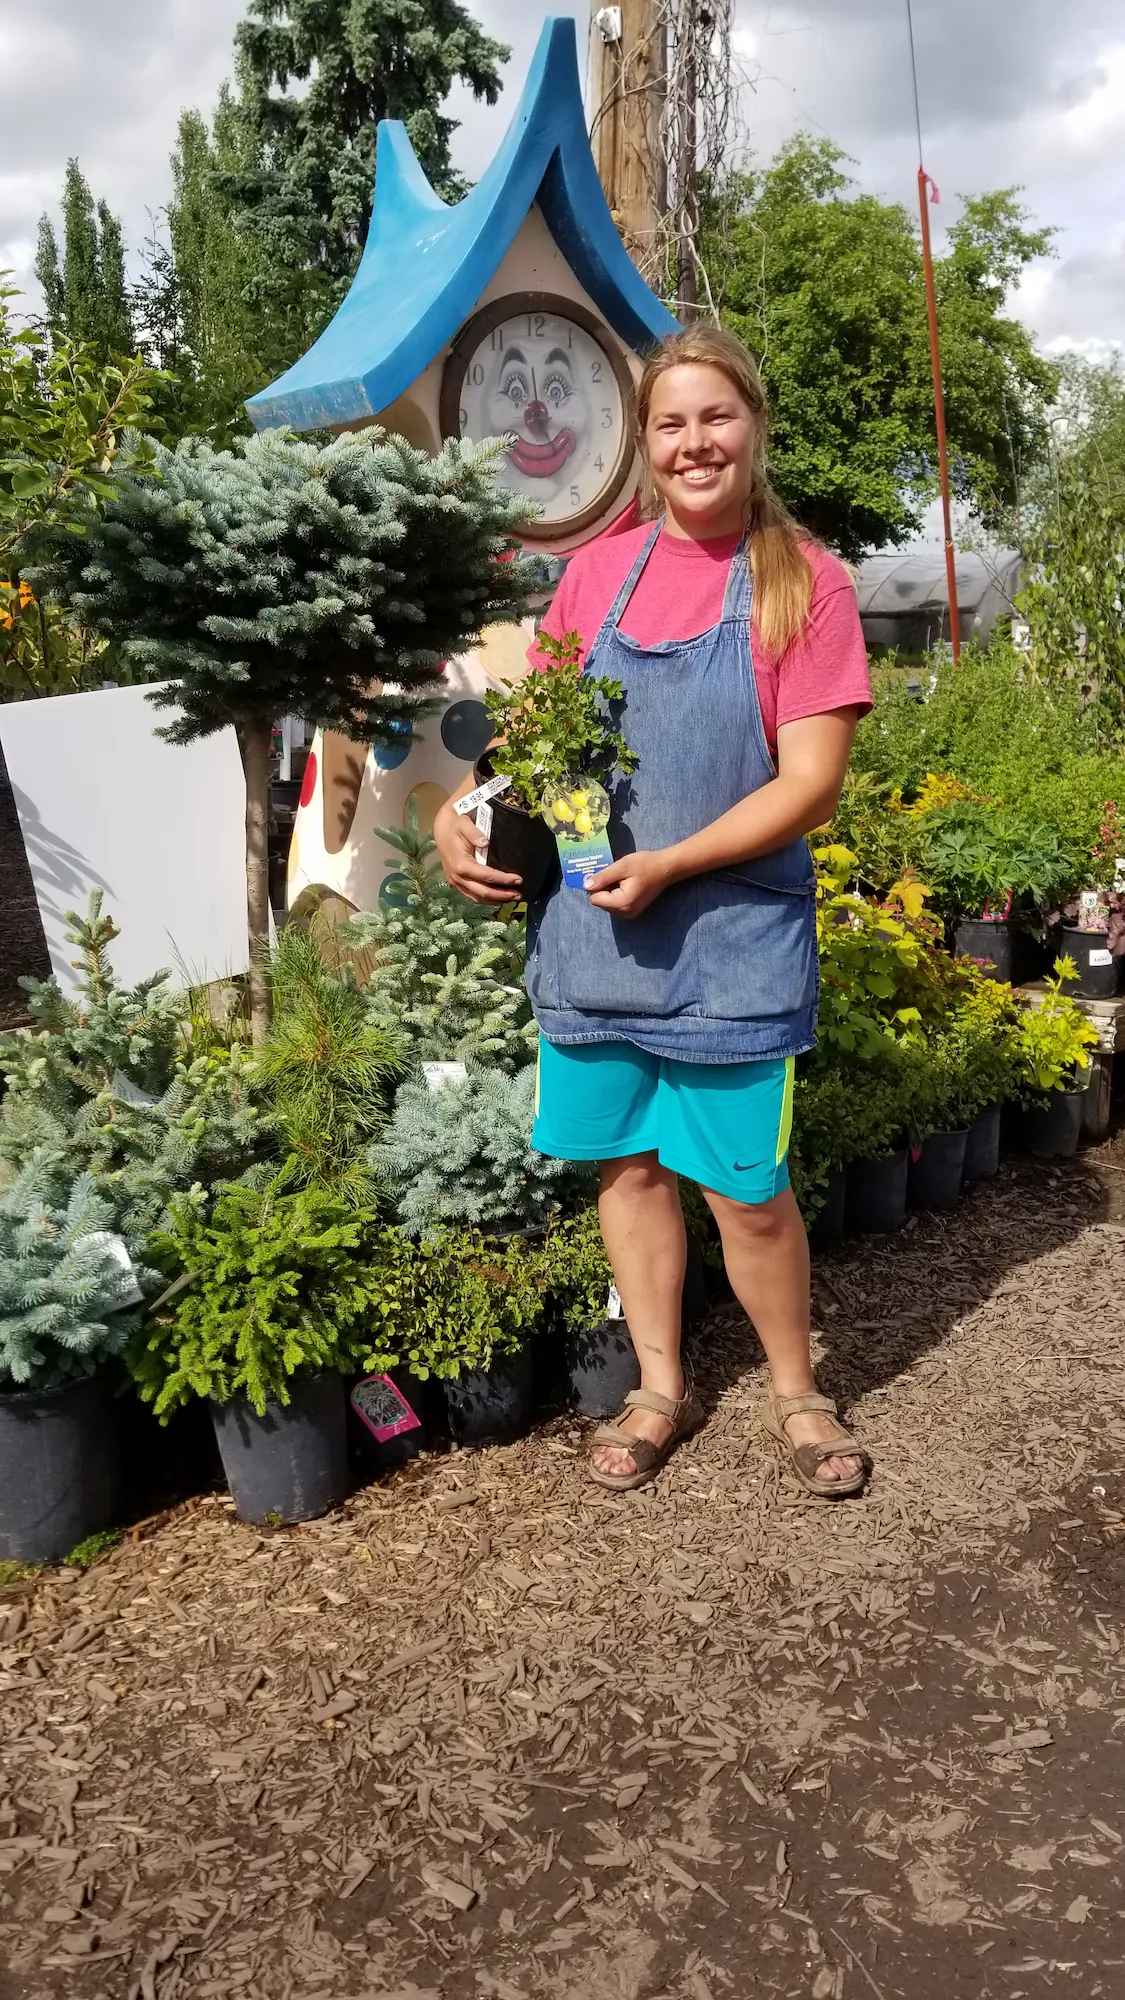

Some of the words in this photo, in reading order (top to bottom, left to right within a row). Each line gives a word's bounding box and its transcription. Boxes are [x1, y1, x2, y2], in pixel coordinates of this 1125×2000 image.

[526, 315, 545, 337] 12
[491, 329, 504, 351] 11
[567, 328, 573, 349] 1
[465, 364, 485, 386] 10
[591, 361, 602, 383] 2
[459, 408, 468, 430] 9
[601, 407, 613, 429] 3
[593, 453, 604, 473] 4
[570, 485, 581, 506] 5
